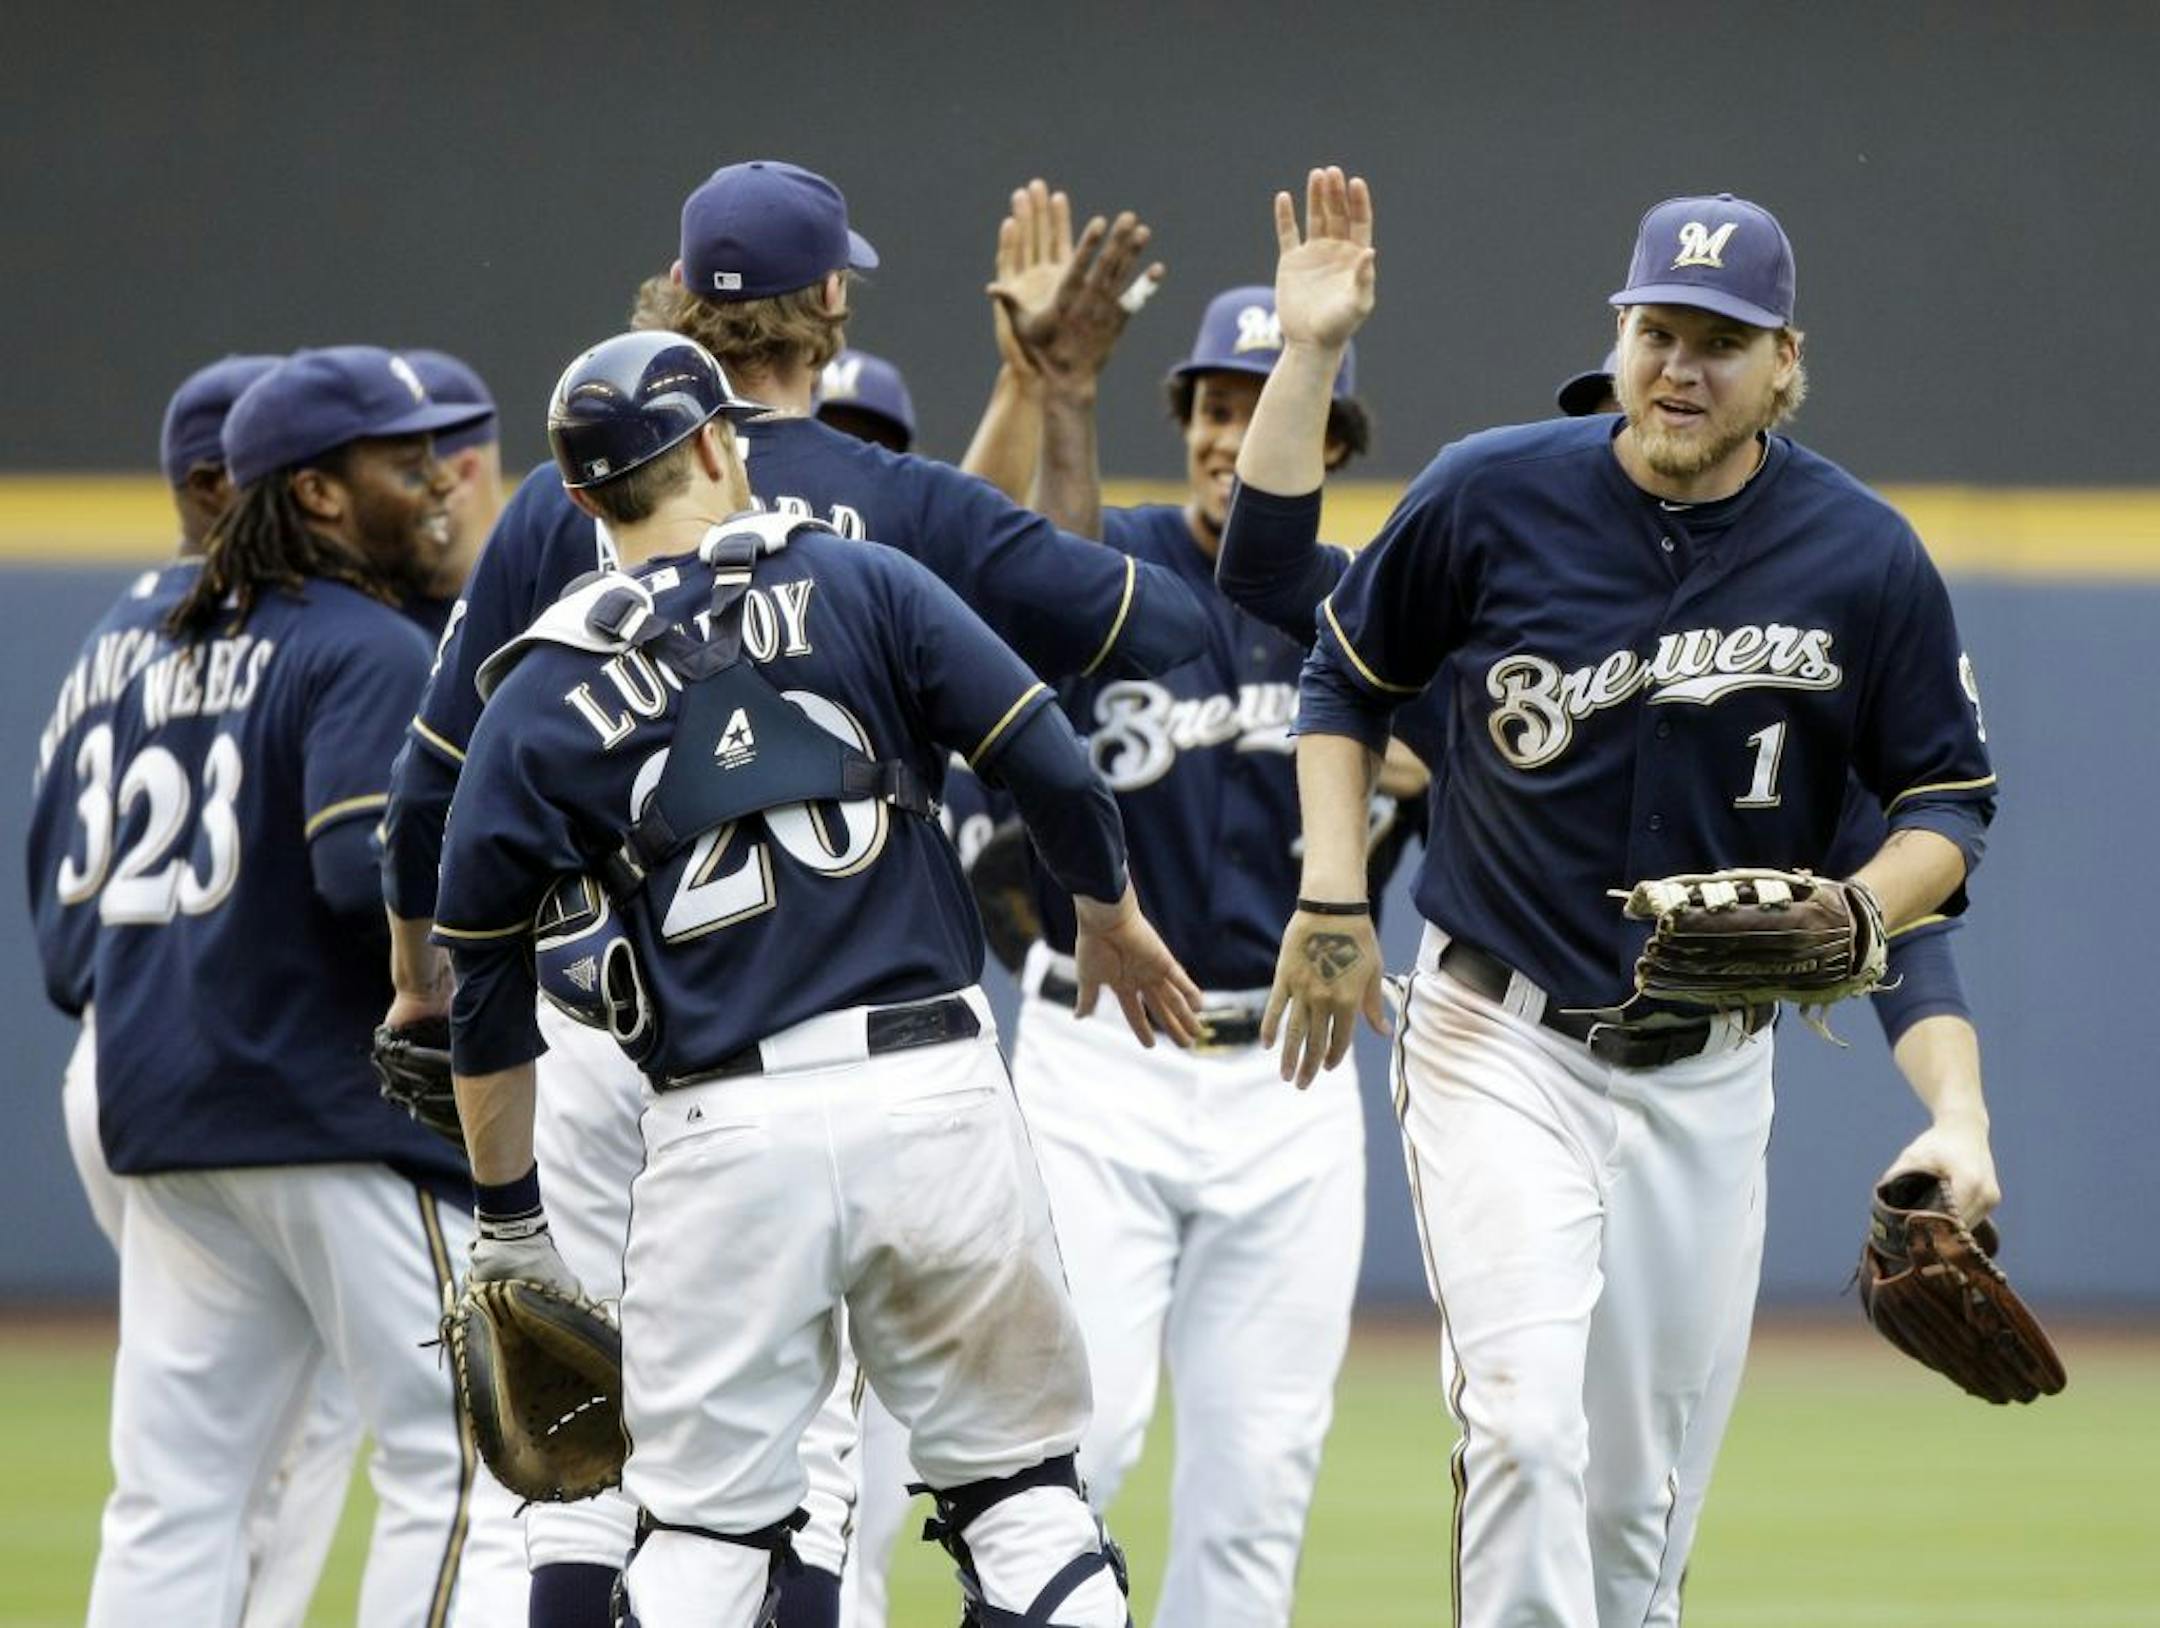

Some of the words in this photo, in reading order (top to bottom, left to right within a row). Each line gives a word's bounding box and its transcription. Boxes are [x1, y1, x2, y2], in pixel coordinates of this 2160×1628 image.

[1669, 222, 1739, 271] M
[564, 579, 815, 752] LUOY
[1089, 680, 1301, 791] Brew
[1486, 622, 1843, 770] Brewers
[100, 732, 243, 926] 23
[630, 690, 890, 939] 20
[1733, 720, 1787, 809] 1
